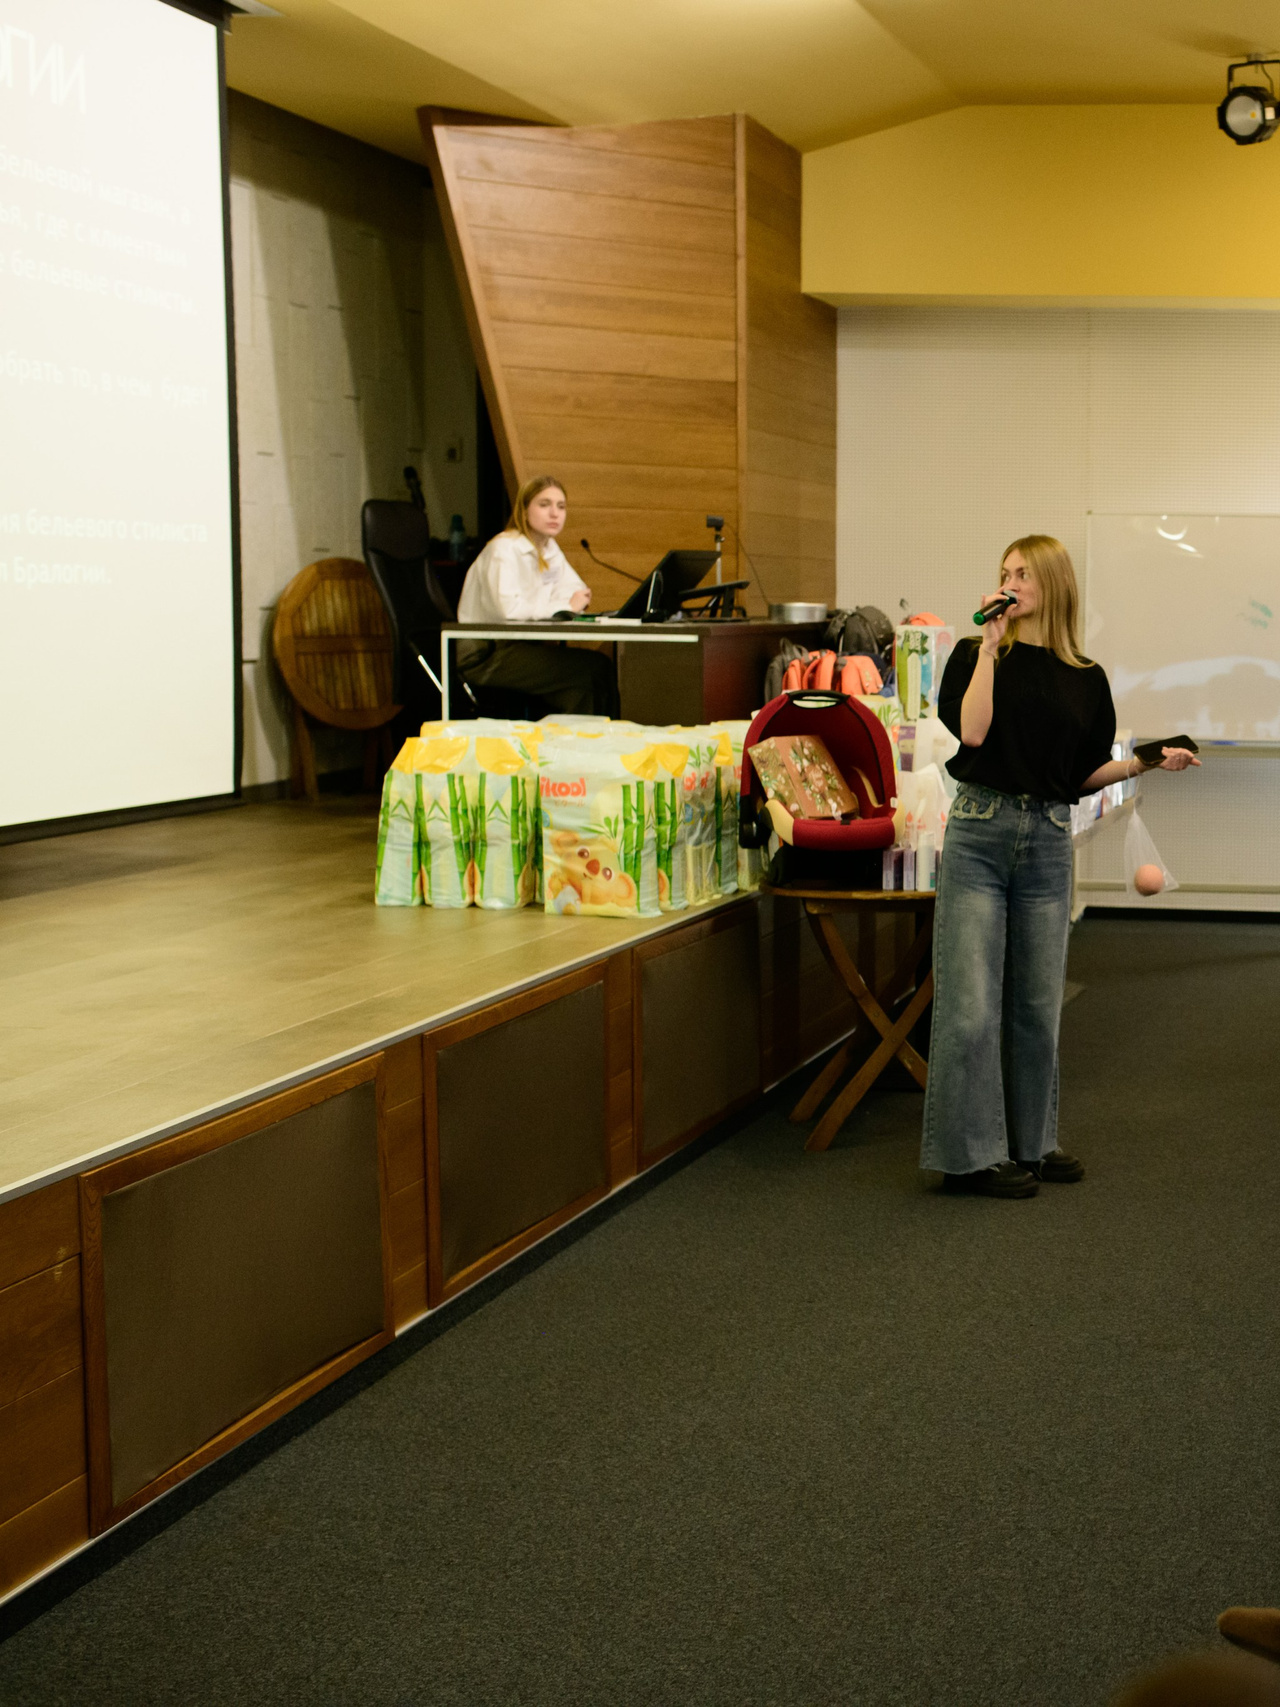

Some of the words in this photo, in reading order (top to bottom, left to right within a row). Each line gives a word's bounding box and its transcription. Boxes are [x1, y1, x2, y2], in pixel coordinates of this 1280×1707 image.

[0, 22, 87, 115] ГИИ
[97, 181, 177, 228] магазин,
[181, 205, 192, 225] а
[34, 210, 70, 242] где
[74, 221, 86, 243] с
[90, 226, 188, 269] клиентами
[11, 249, 109, 296] бельевые
[113, 279, 199, 316] стилисты.
[70, 366, 98, 395] то,
[101, 371, 112, 392] в
[116, 375, 153, 399] чем
[160, 376, 209, 409] будет
[26, 508, 127, 540] бельевого
[131, 519, 209, 542] стилиста
[13, 556, 112, 590] Бралогии.
